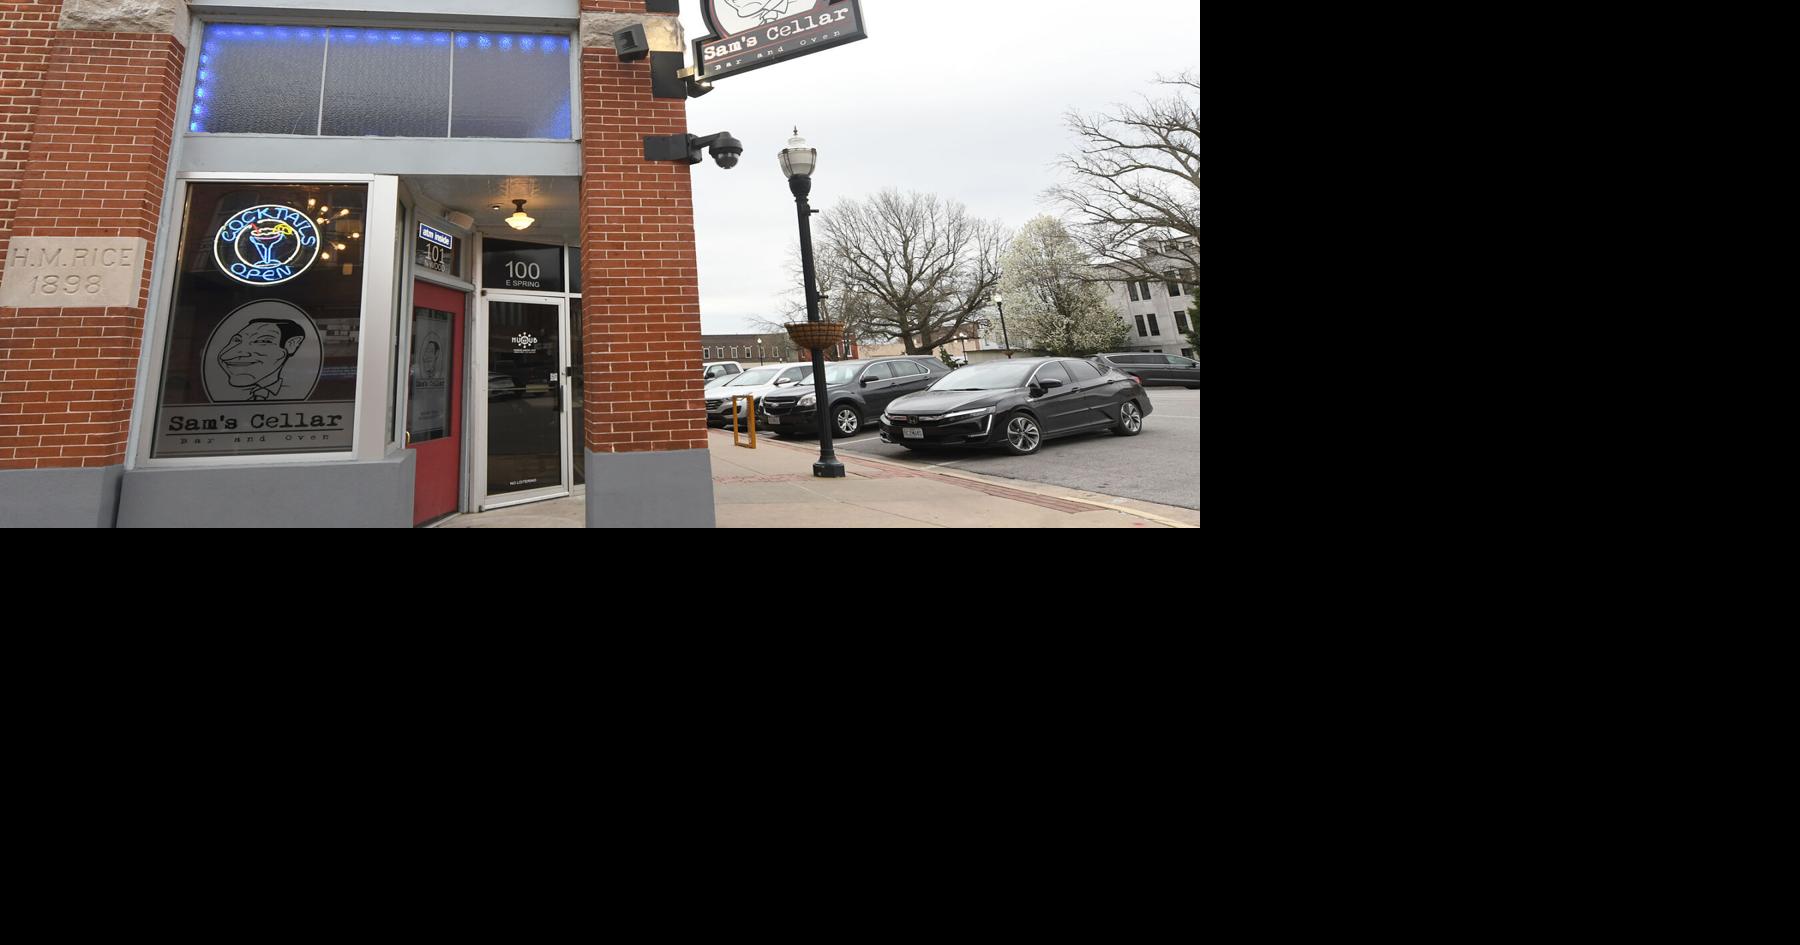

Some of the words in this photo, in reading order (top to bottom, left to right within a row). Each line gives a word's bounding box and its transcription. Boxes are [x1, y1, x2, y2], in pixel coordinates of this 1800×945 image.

[703, 35, 759, 61] Sam's
[766, 7, 849, 41] Cellar
[714, 58, 743, 71] Bar
[756, 46, 785, 59] and
[799, 30, 841, 47] Oven
[221, 207, 316, 247] COCKTAILS
[422, 228, 434, 239] atm
[425, 243, 446, 265] 101
[505, 260, 541, 280] 100
[30, 274, 102, 294] 1898
[505, 279, 512, 287] E
[512, 279, 541, 288] SPRING
[168, 414, 238, 432] Sam's
[250, 411, 343, 430] Cellar
[179, 437, 215, 445] Bar
[233, 435, 267, 443] and
[284, 433, 330, 442] Oven
